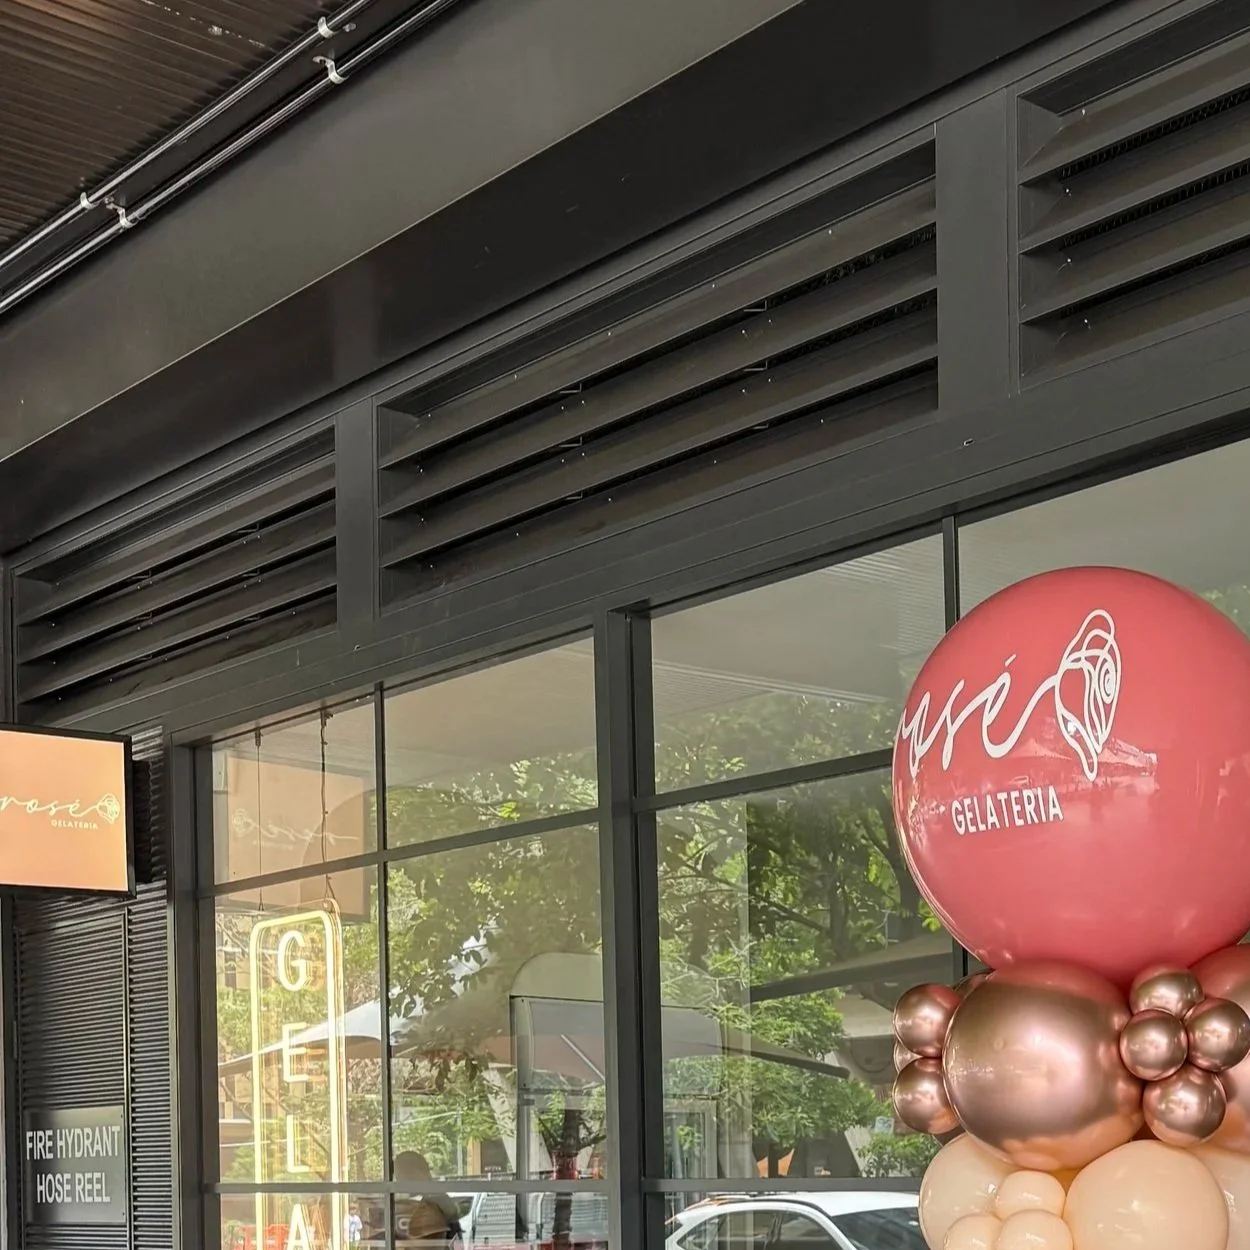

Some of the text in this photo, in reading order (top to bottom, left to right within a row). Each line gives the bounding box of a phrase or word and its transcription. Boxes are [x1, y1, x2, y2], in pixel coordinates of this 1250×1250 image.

[51, 819, 99, 830] GELATERIA
[950, 785, 1064, 836] GELATERIA
[26, 1125, 121, 1160] FIRE HYDRANT
[37, 1172, 111, 1204] HOSE REEL
